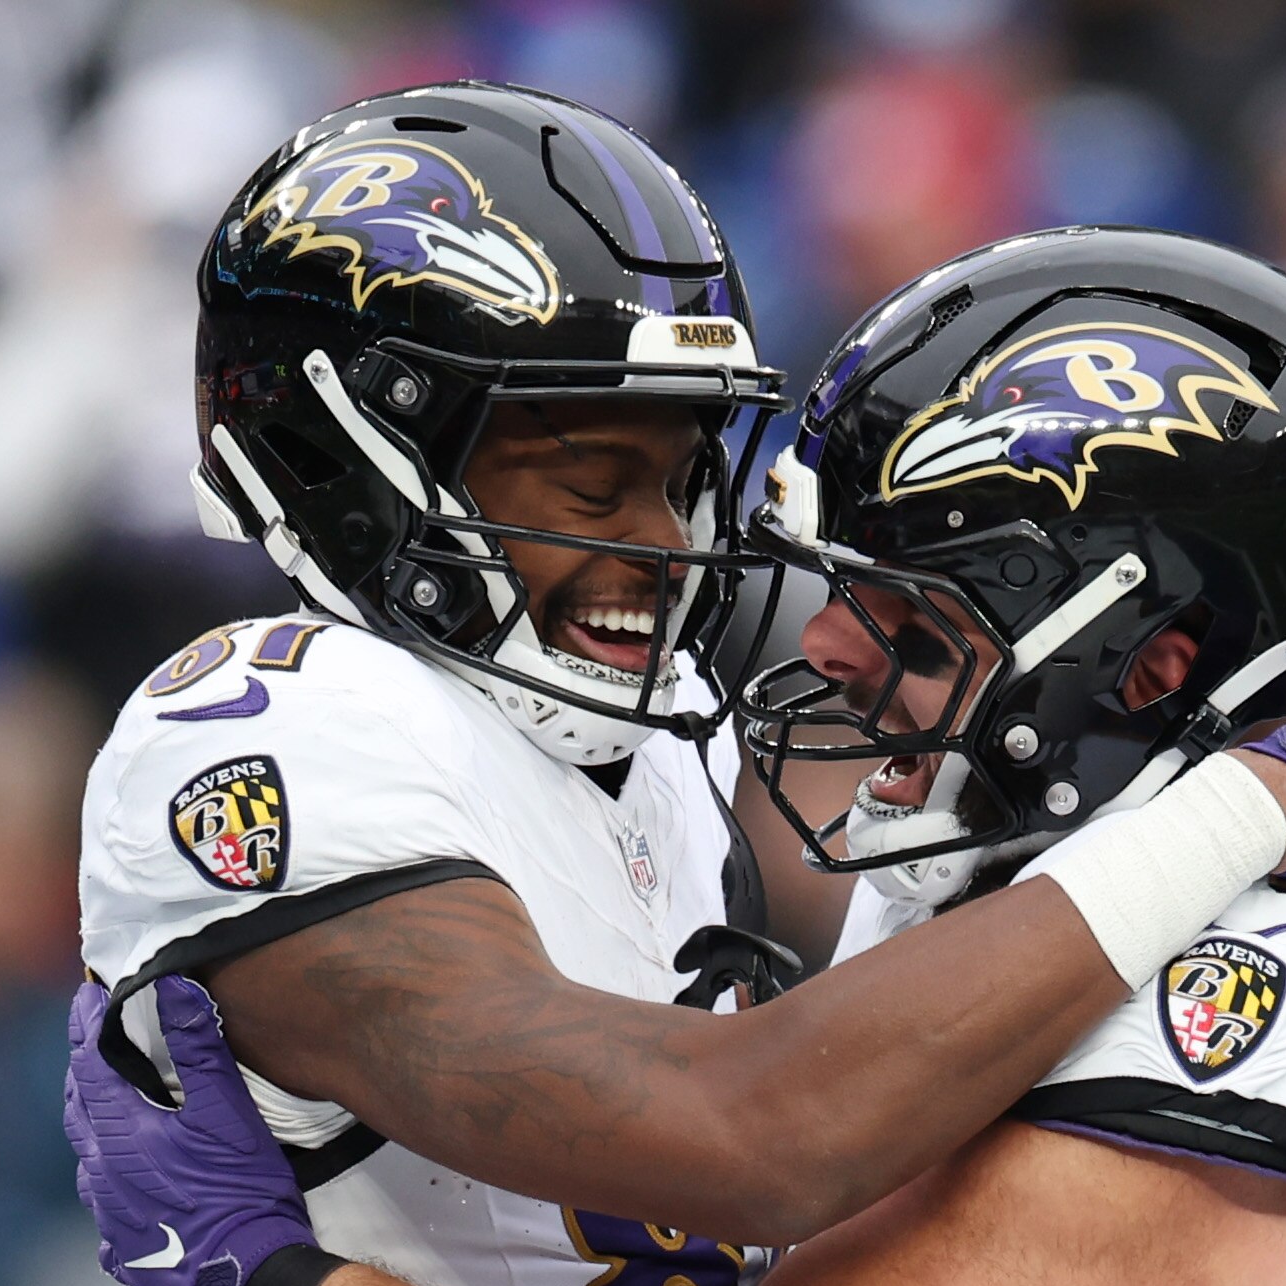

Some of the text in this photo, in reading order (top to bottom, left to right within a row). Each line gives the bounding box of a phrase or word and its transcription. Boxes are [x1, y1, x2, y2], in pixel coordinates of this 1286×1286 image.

[305, 152, 419, 218] B
[672, 322, 736, 349] RAVENS
[1008, 339, 1165, 413] B
[175, 760, 267, 812] RAVENS
